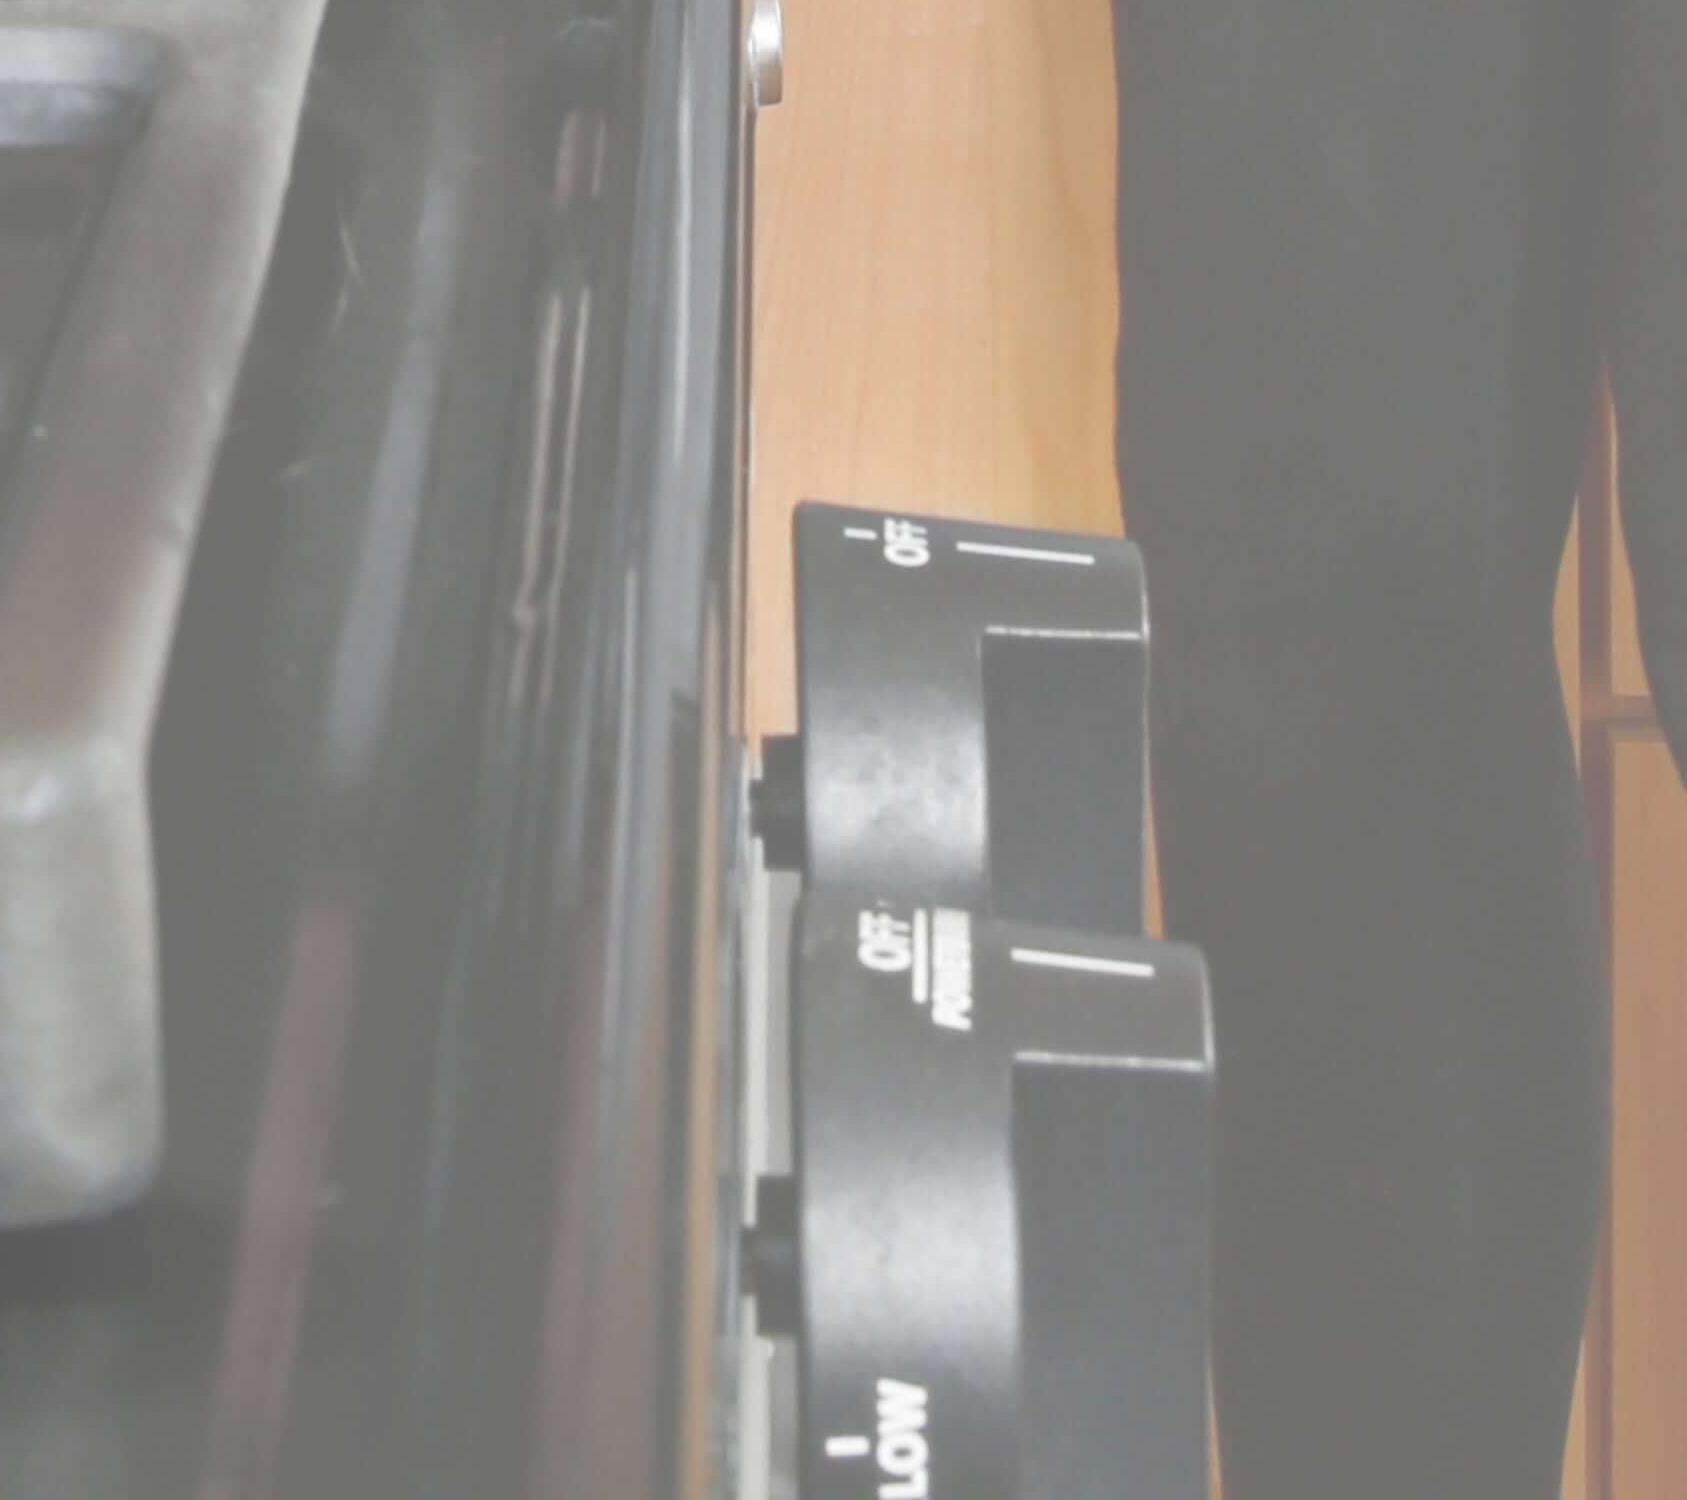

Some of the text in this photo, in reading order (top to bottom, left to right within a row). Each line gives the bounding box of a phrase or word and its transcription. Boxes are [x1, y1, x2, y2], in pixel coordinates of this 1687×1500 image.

[883, 517, 930, 567] OFF
[858, 909, 912, 971] OFF
[876, 1377, 928, 1500] LOW
